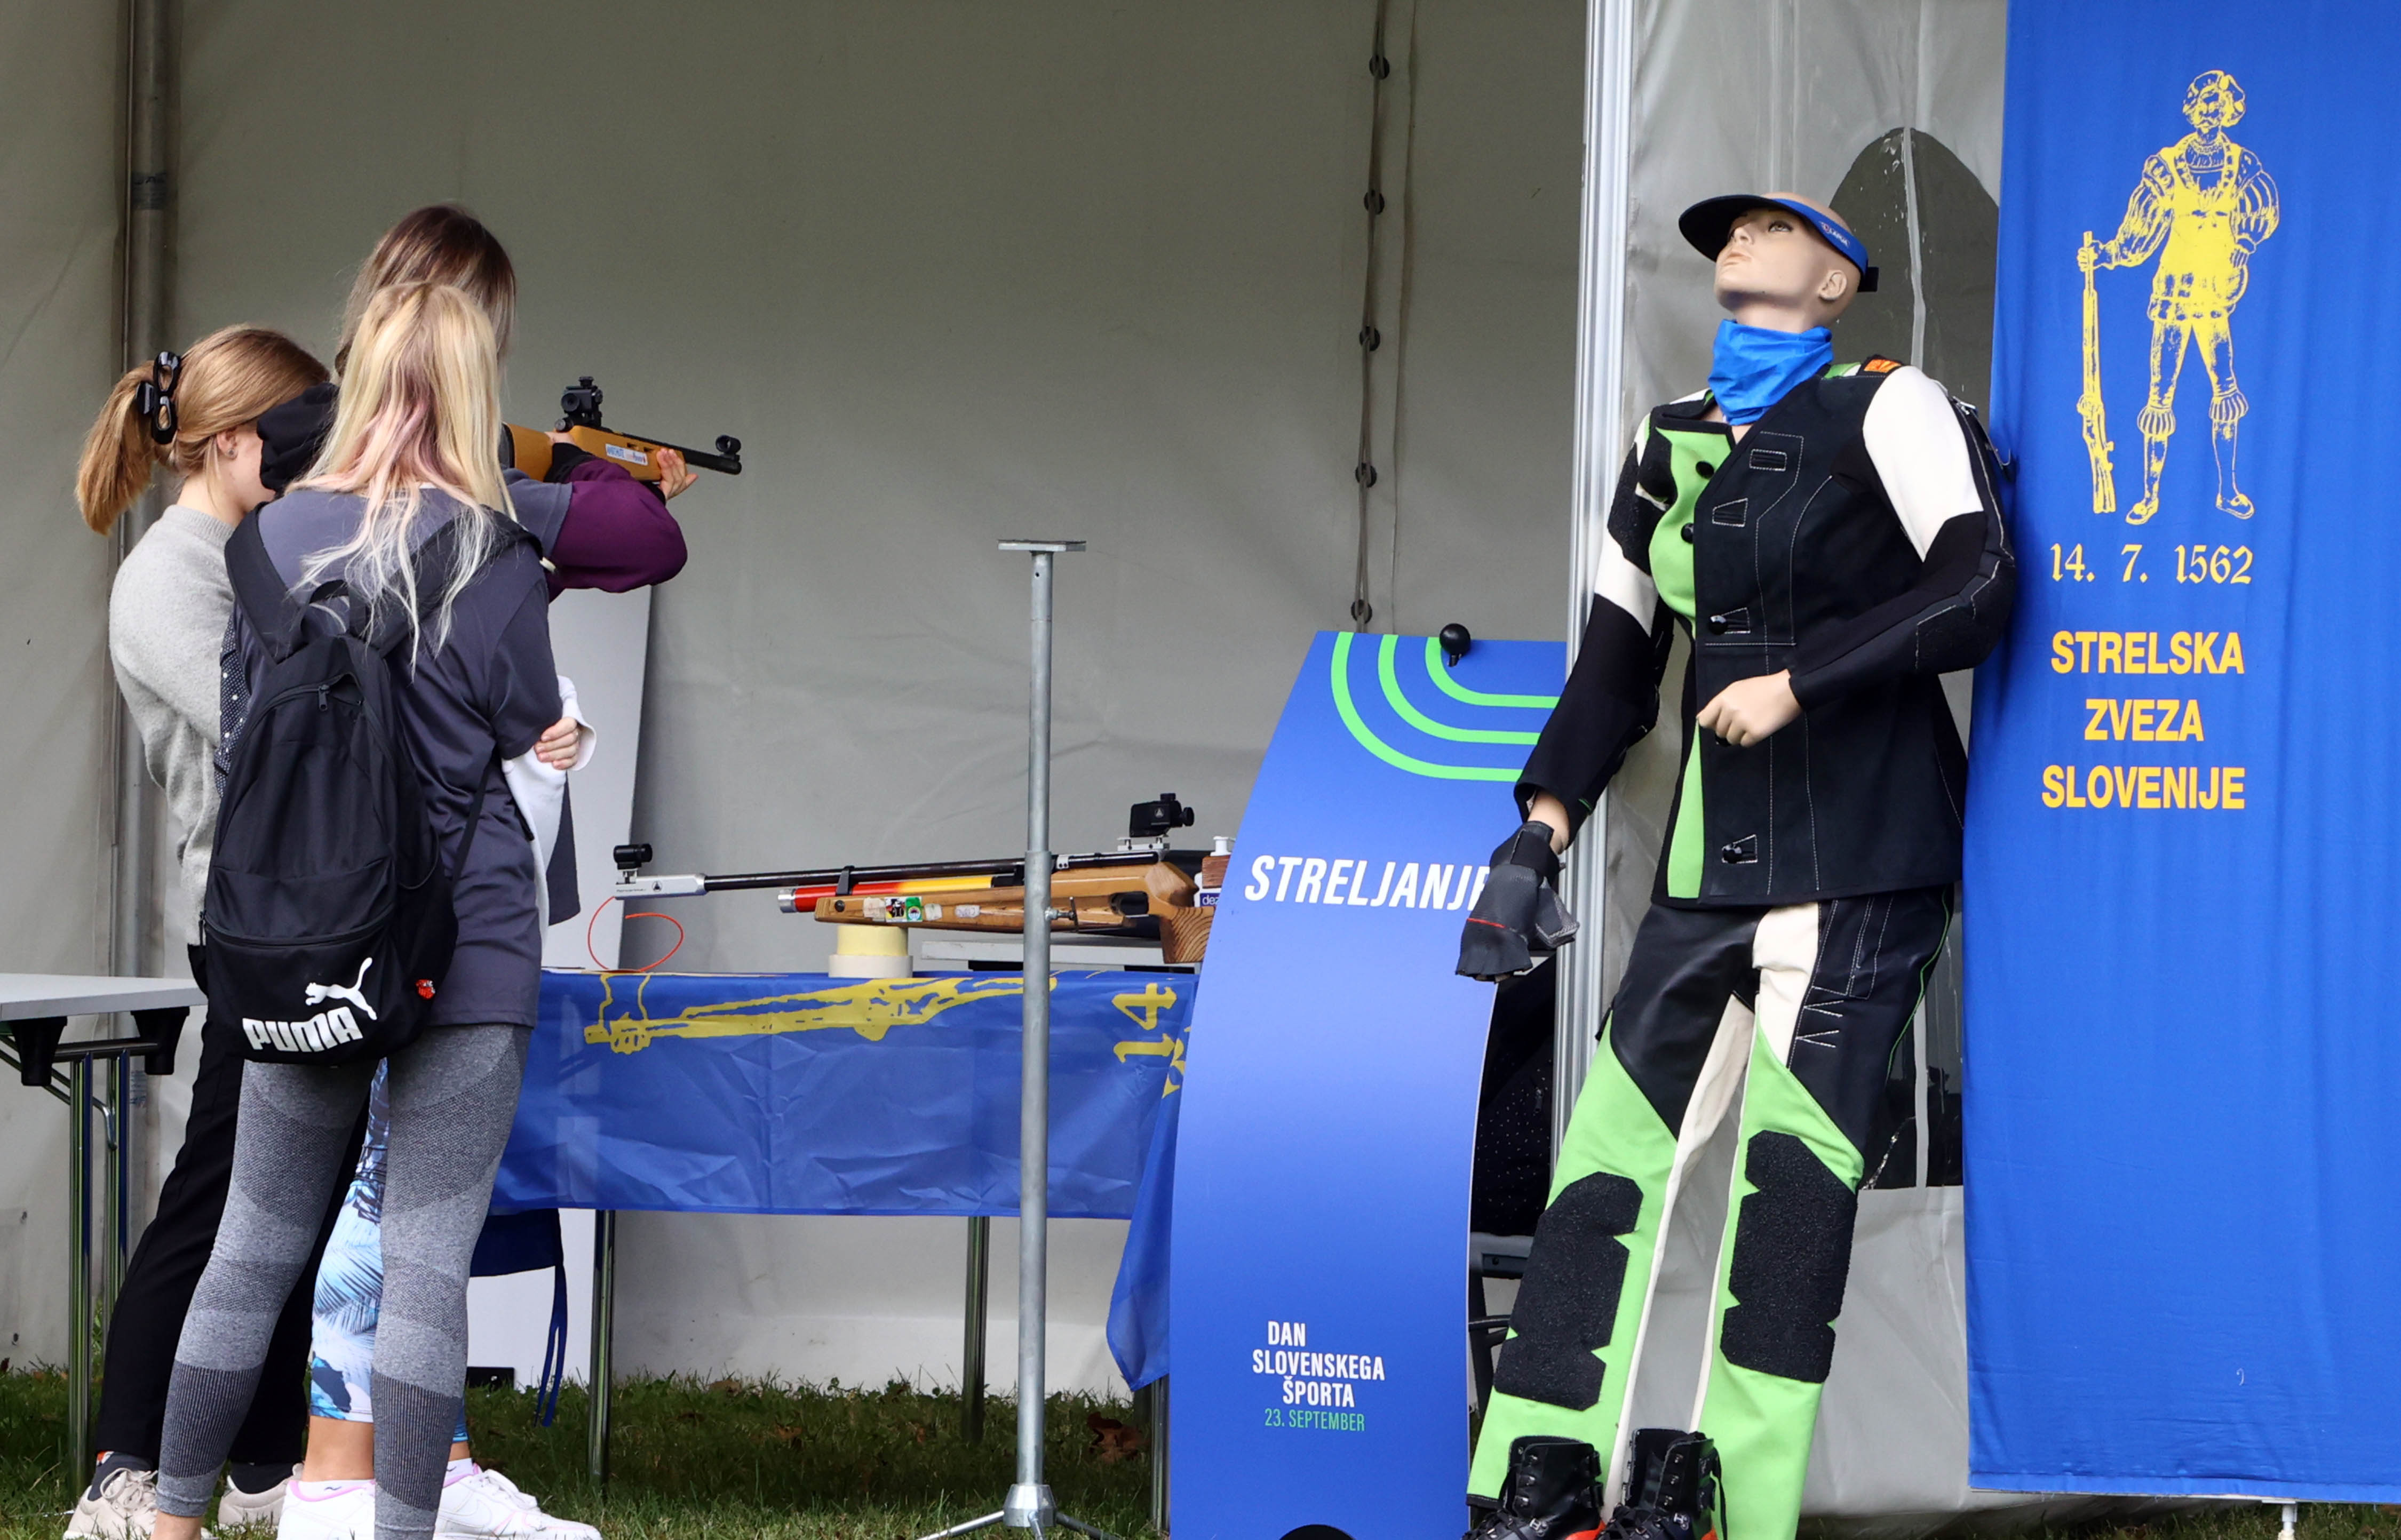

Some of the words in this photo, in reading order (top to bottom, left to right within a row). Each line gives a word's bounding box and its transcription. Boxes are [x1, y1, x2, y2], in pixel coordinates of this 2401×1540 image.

[2050, 544, 2095, 583] 14.
[2121, 544, 2149, 583] 7.
[2174, 545, 2253, 584] 1562
[2051, 631, 2245, 675] STRELSKA
[2084, 698, 2205, 742] ZVEZA
[2041, 765, 2246, 810] SLOVENIJE
[242, 1006, 363, 1052] PUMA
[1268, 1320, 1306, 1347] DAN
[1252, 1349, 1385, 1381] SLOVENSKEGA
[1283, 1376, 1355, 1407] ŠPORTA
[1265, 1408, 1285, 1427] 23.
[1289, 1409, 1365, 1432] SEPTEMBER
